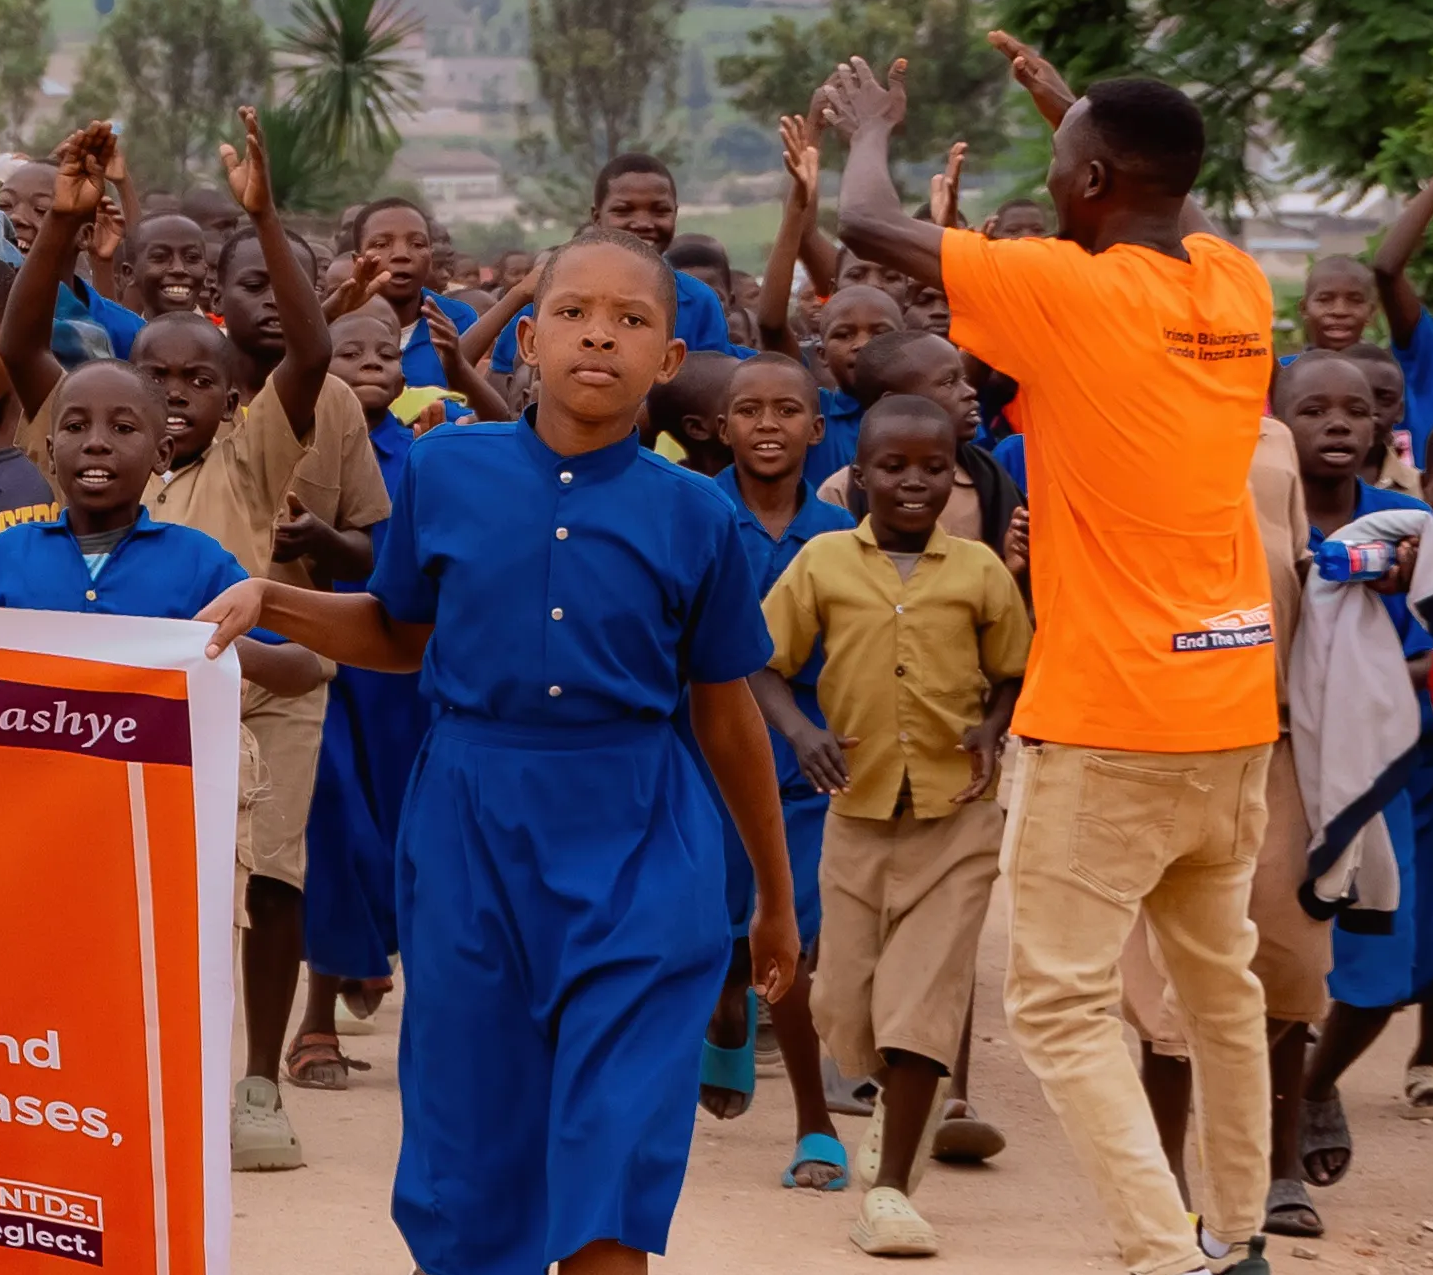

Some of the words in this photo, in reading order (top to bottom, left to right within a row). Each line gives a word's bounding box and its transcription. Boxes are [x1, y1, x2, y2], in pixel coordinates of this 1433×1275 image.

[1176, 633, 1207, 649] End
[1208, 632, 1234, 646] The
[0, 1185, 95, 1224] NTDs.
